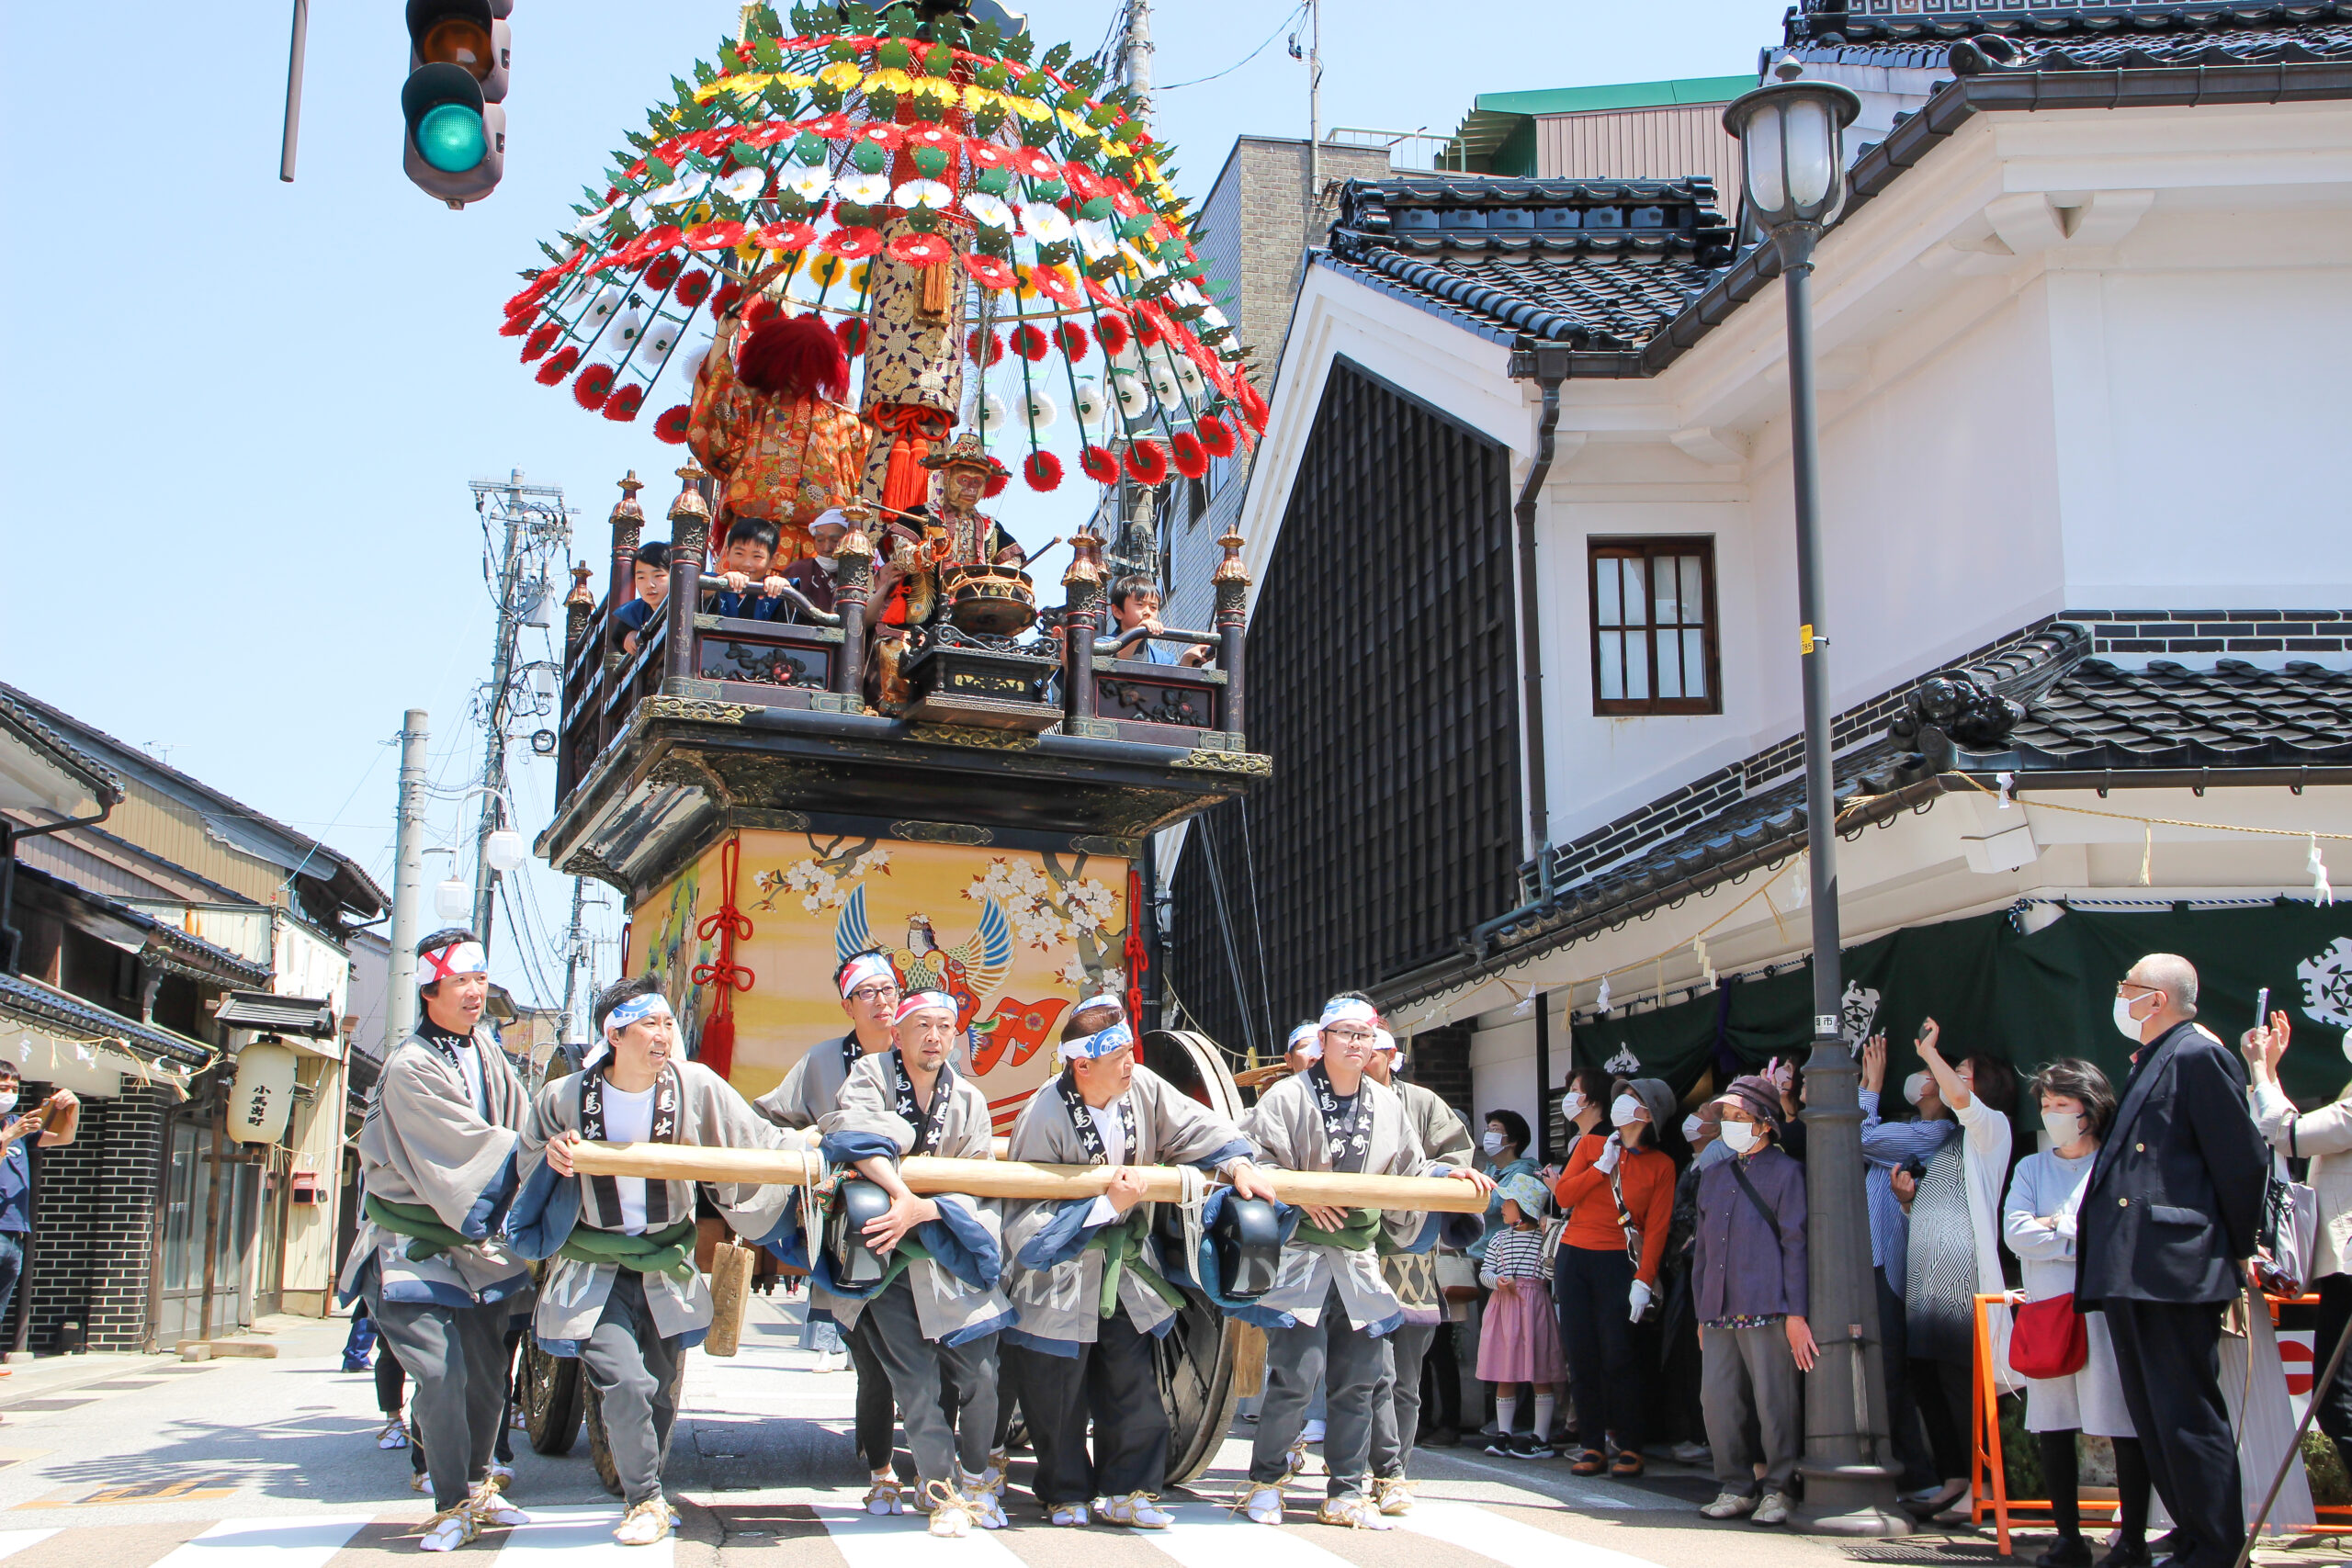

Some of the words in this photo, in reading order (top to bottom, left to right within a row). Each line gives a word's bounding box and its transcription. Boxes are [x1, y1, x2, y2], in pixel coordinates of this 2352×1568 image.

[247, 1085, 272, 1127] 小馬出町
[582, 1073, 603, 1140] 小馬出
[655, 1070, 677, 1136] 小馬出
